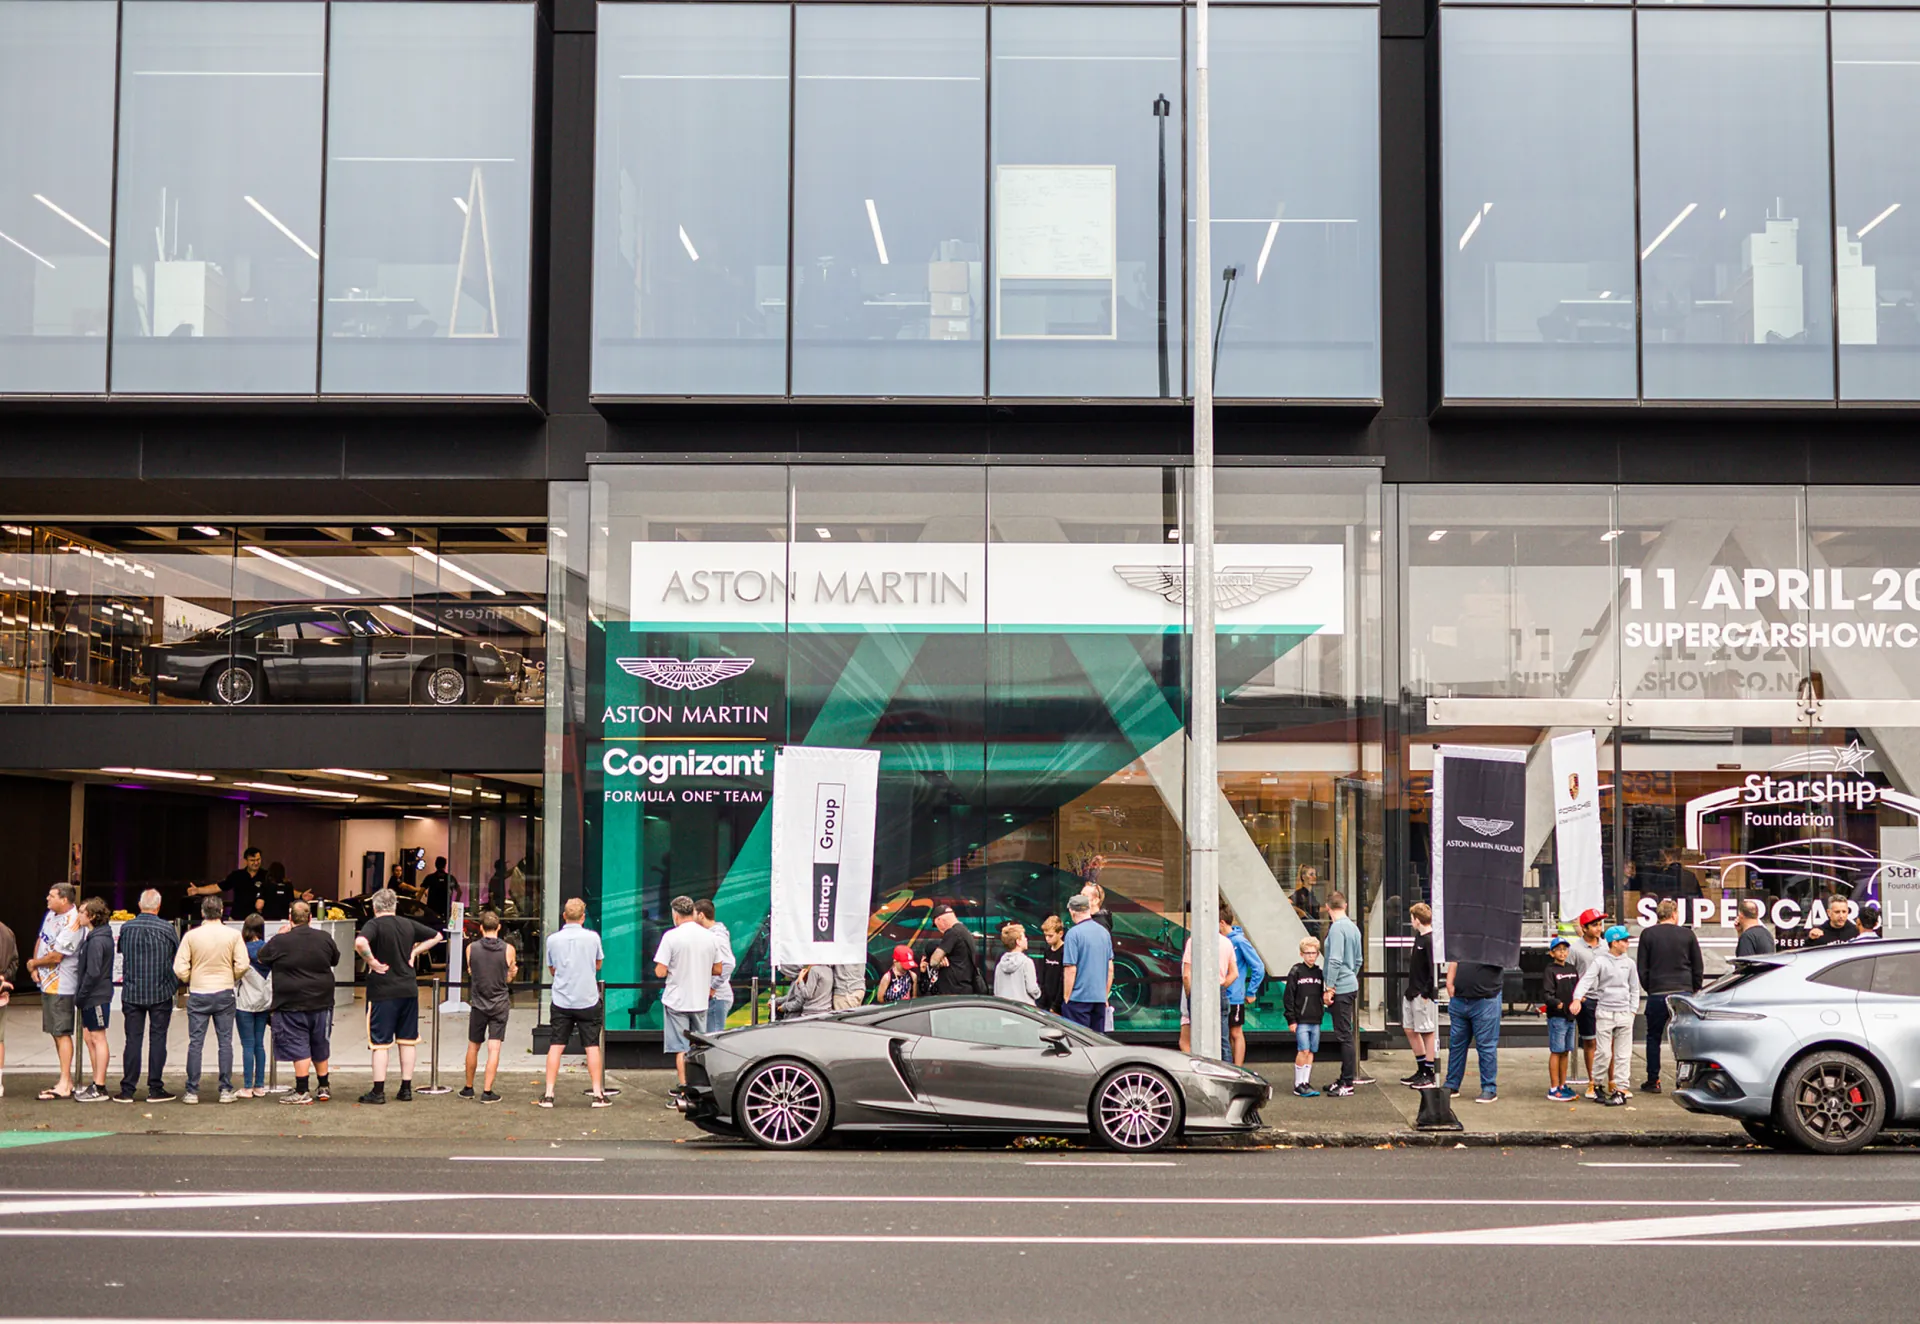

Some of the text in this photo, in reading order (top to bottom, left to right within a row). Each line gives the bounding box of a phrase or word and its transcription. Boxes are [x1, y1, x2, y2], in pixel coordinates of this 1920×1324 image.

[662, 570, 967, 603] ASTON MARTIN
[1623, 568, 1676, 610] 11
[1701, 568, 1855, 610] APRIL
[602, 706, 768, 723] ASTON MARTIN
[602, 748, 765, 784] Cognizant
[604, 790, 676, 802] FORMULA
[724, 790, 763, 803] TEAM
[1744, 774, 1876, 810] Starship
[1745, 812, 1834, 827] Foundation
[1446, 840, 1469, 848] ASTON
[1470, 841, 1493, 850] MARTIN
[818, 798, 840, 932] Giltrap Group
